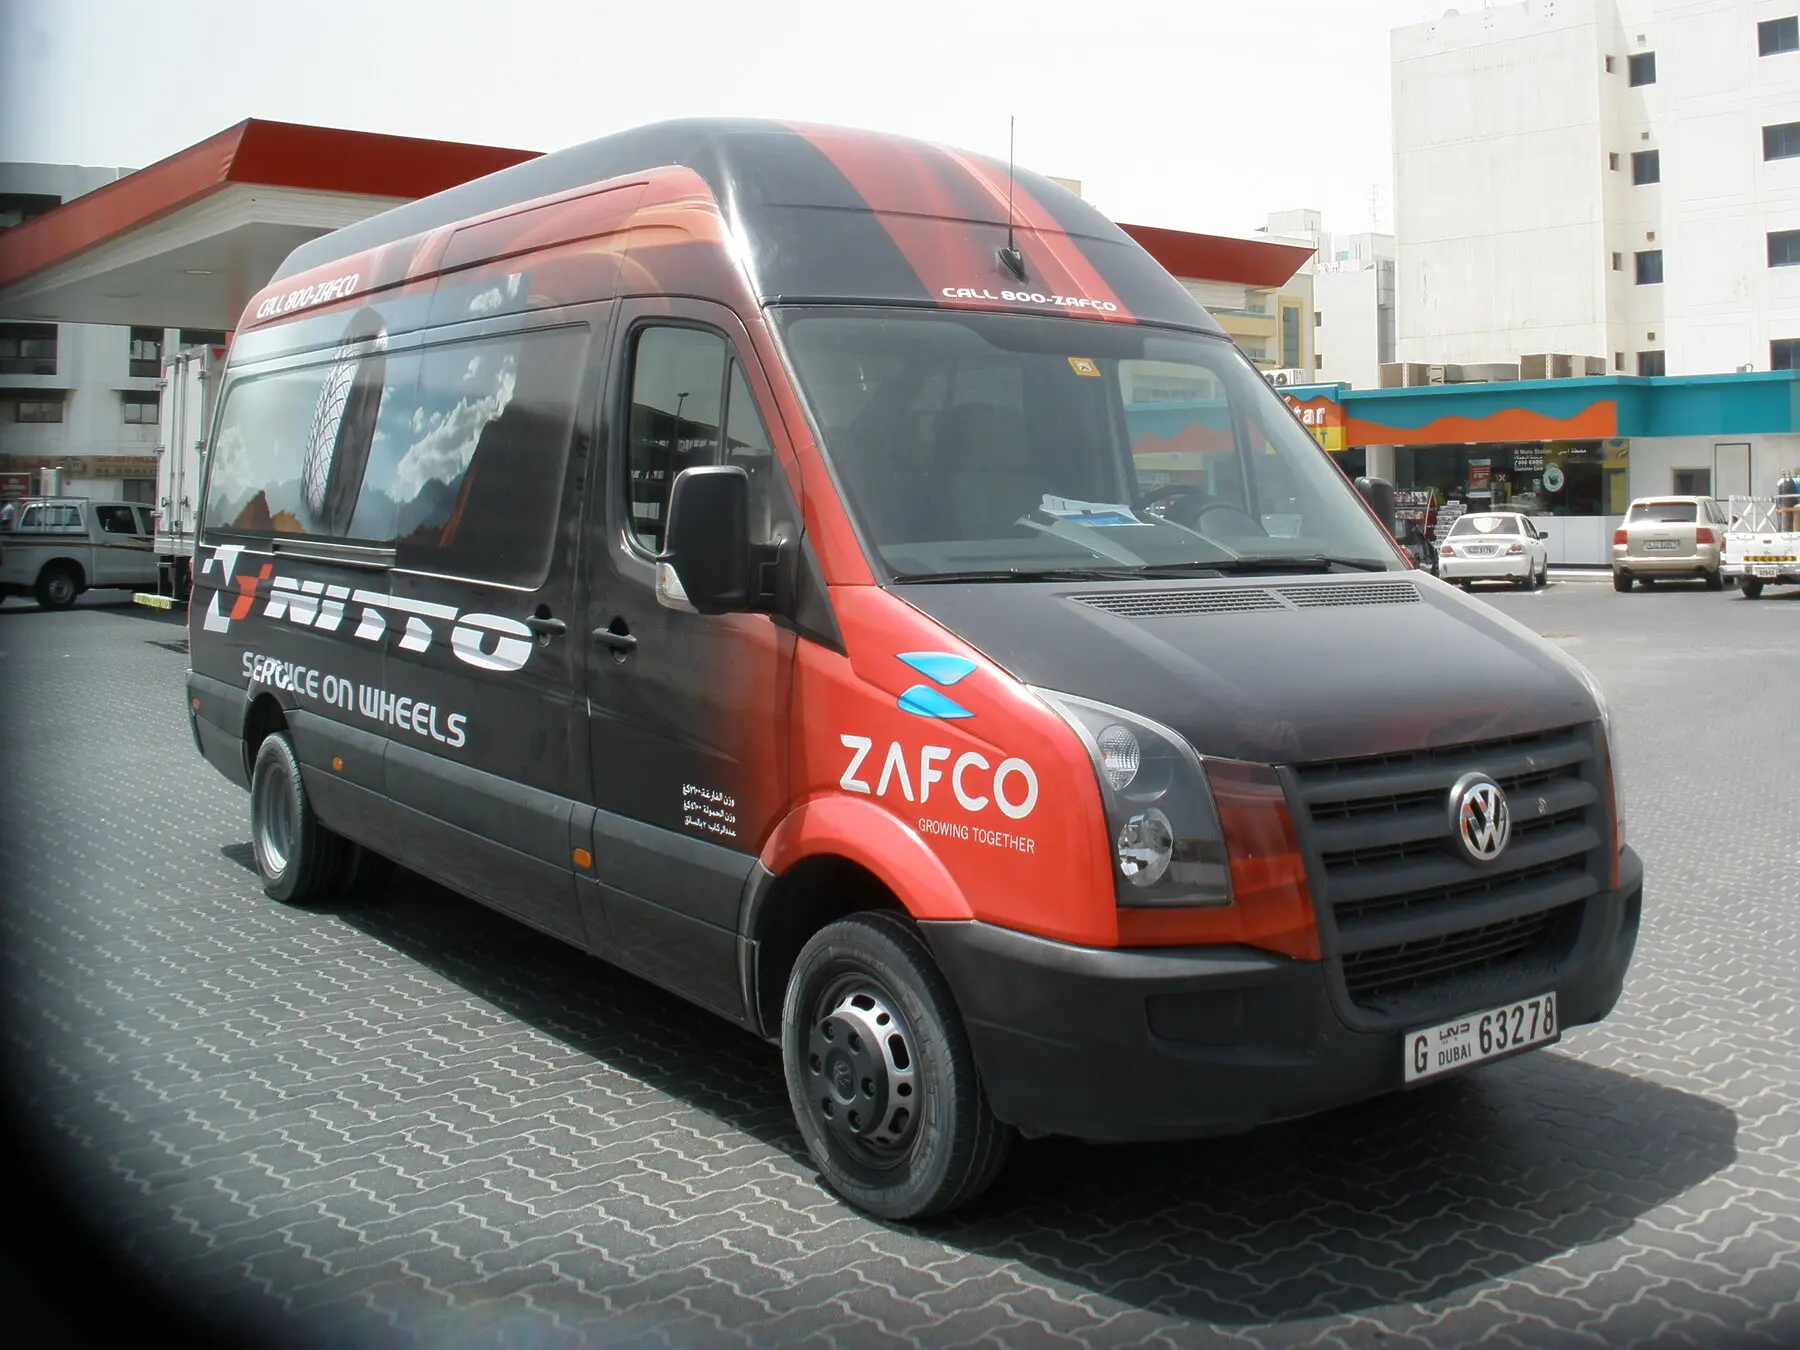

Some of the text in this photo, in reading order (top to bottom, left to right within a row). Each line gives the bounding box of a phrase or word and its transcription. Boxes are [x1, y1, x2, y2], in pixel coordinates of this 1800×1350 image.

[256, 273, 360, 319] CALL 800-ZAFCO
[941, 286, 1118, 313] CALL 800-ZAFCO
[263, 576, 533, 672] NITTO
[358, 686, 467, 748] WHEELS
[839, 733, 1038, 820] ZAFCO
[917, 817, 1035, 854] GROWING TOGETHER
[1414, 996, 1553, 1073] G DUBAI 63278
